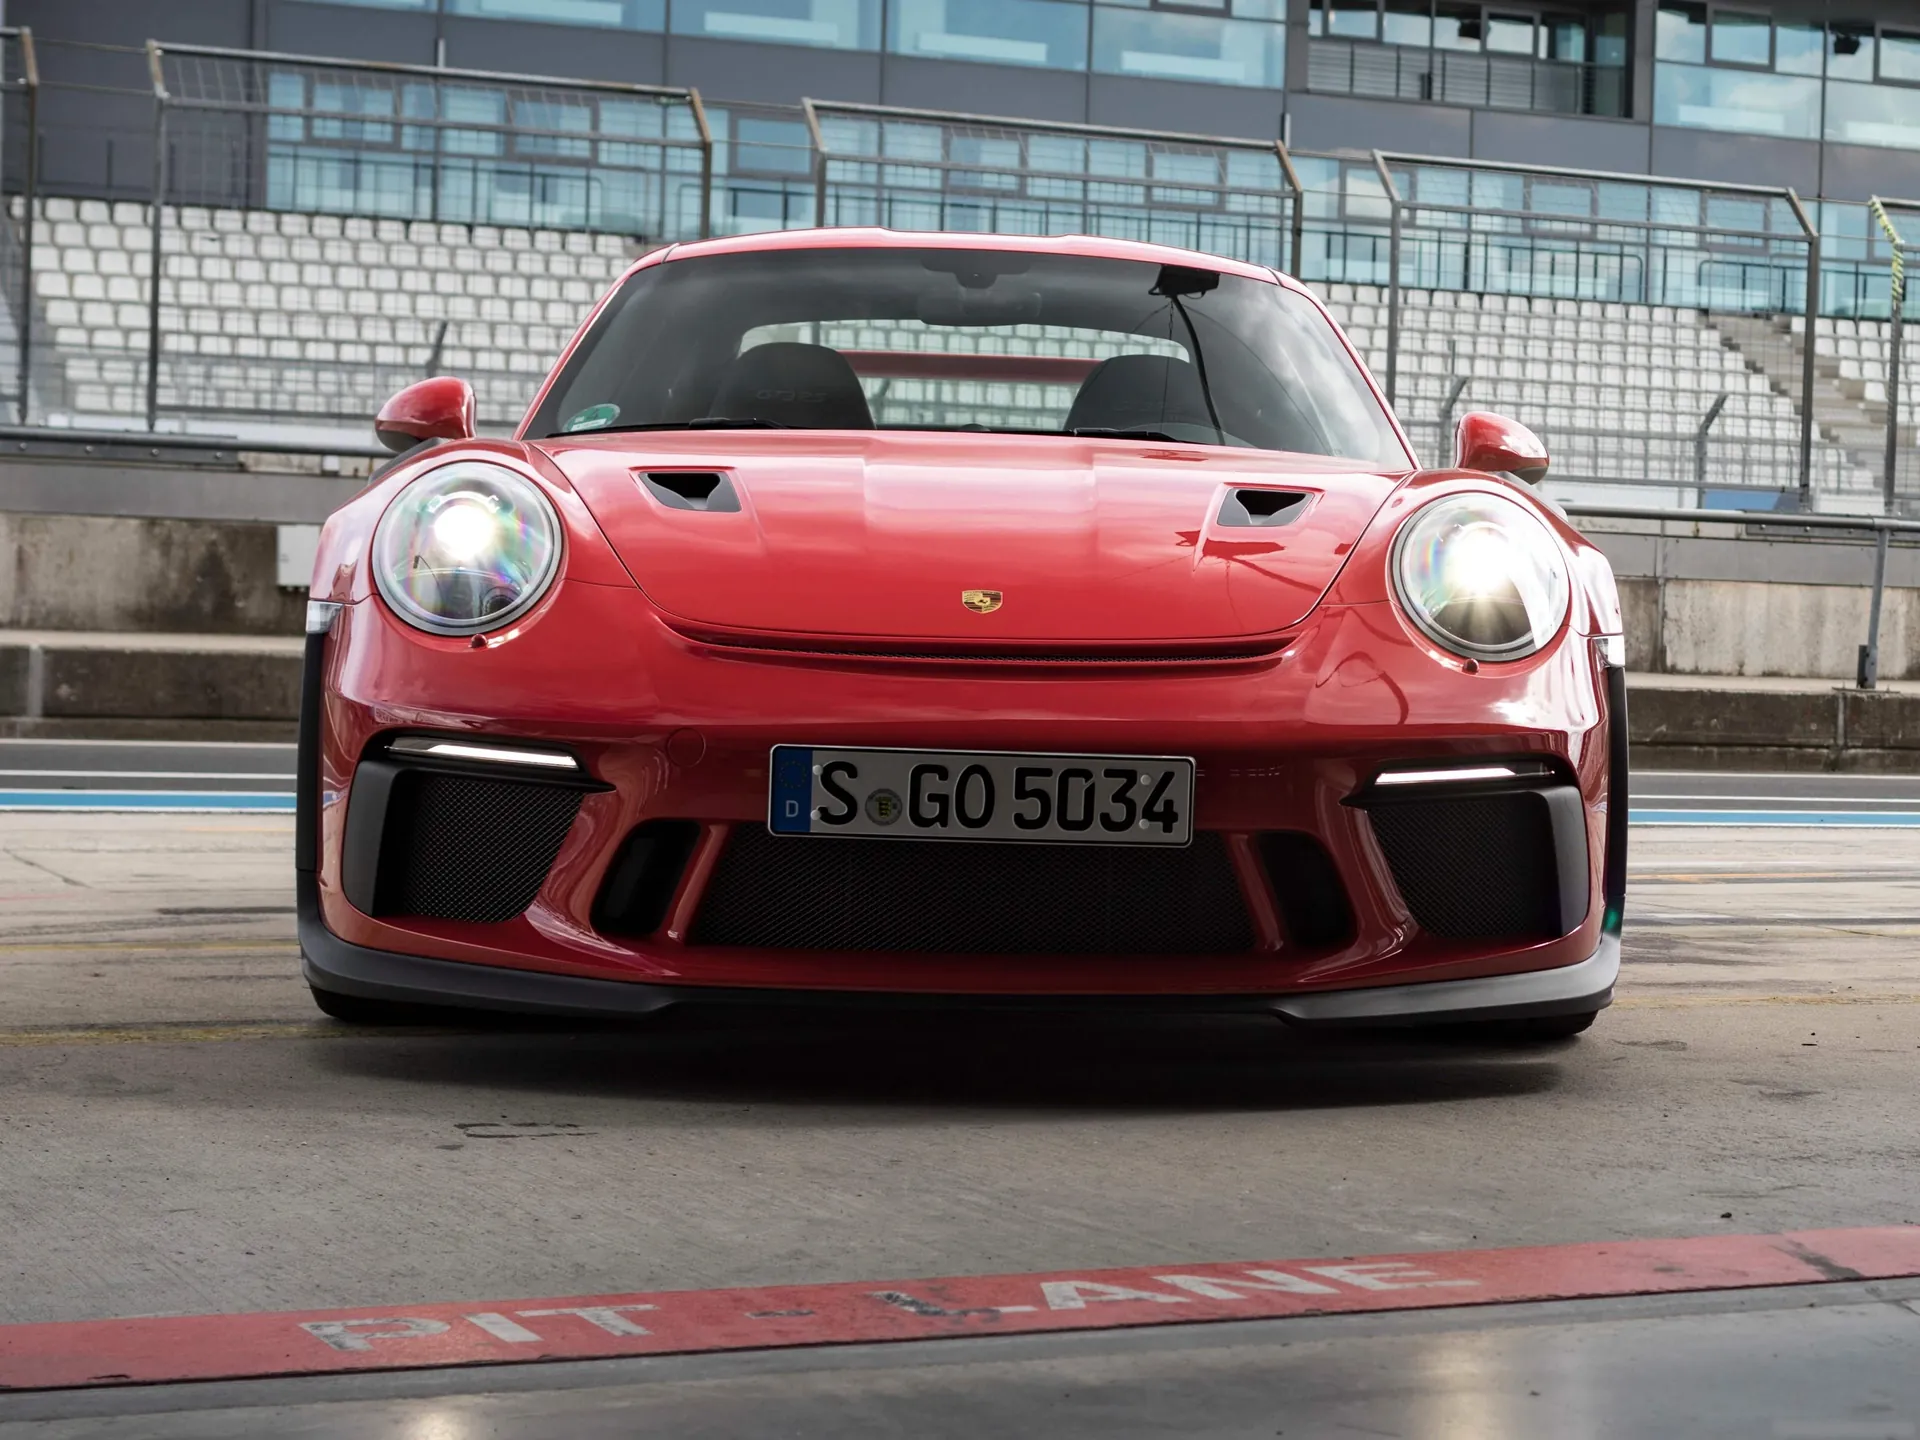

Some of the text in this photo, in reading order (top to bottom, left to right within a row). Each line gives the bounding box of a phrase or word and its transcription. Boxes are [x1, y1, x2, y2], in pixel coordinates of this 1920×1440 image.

[785, 799, 799, 818] D
[818, 761, 1179, 834] S GO 5034
[298, 1303, 661, 1352] PIT
[872, 1261, 1482, 1318] LANE
